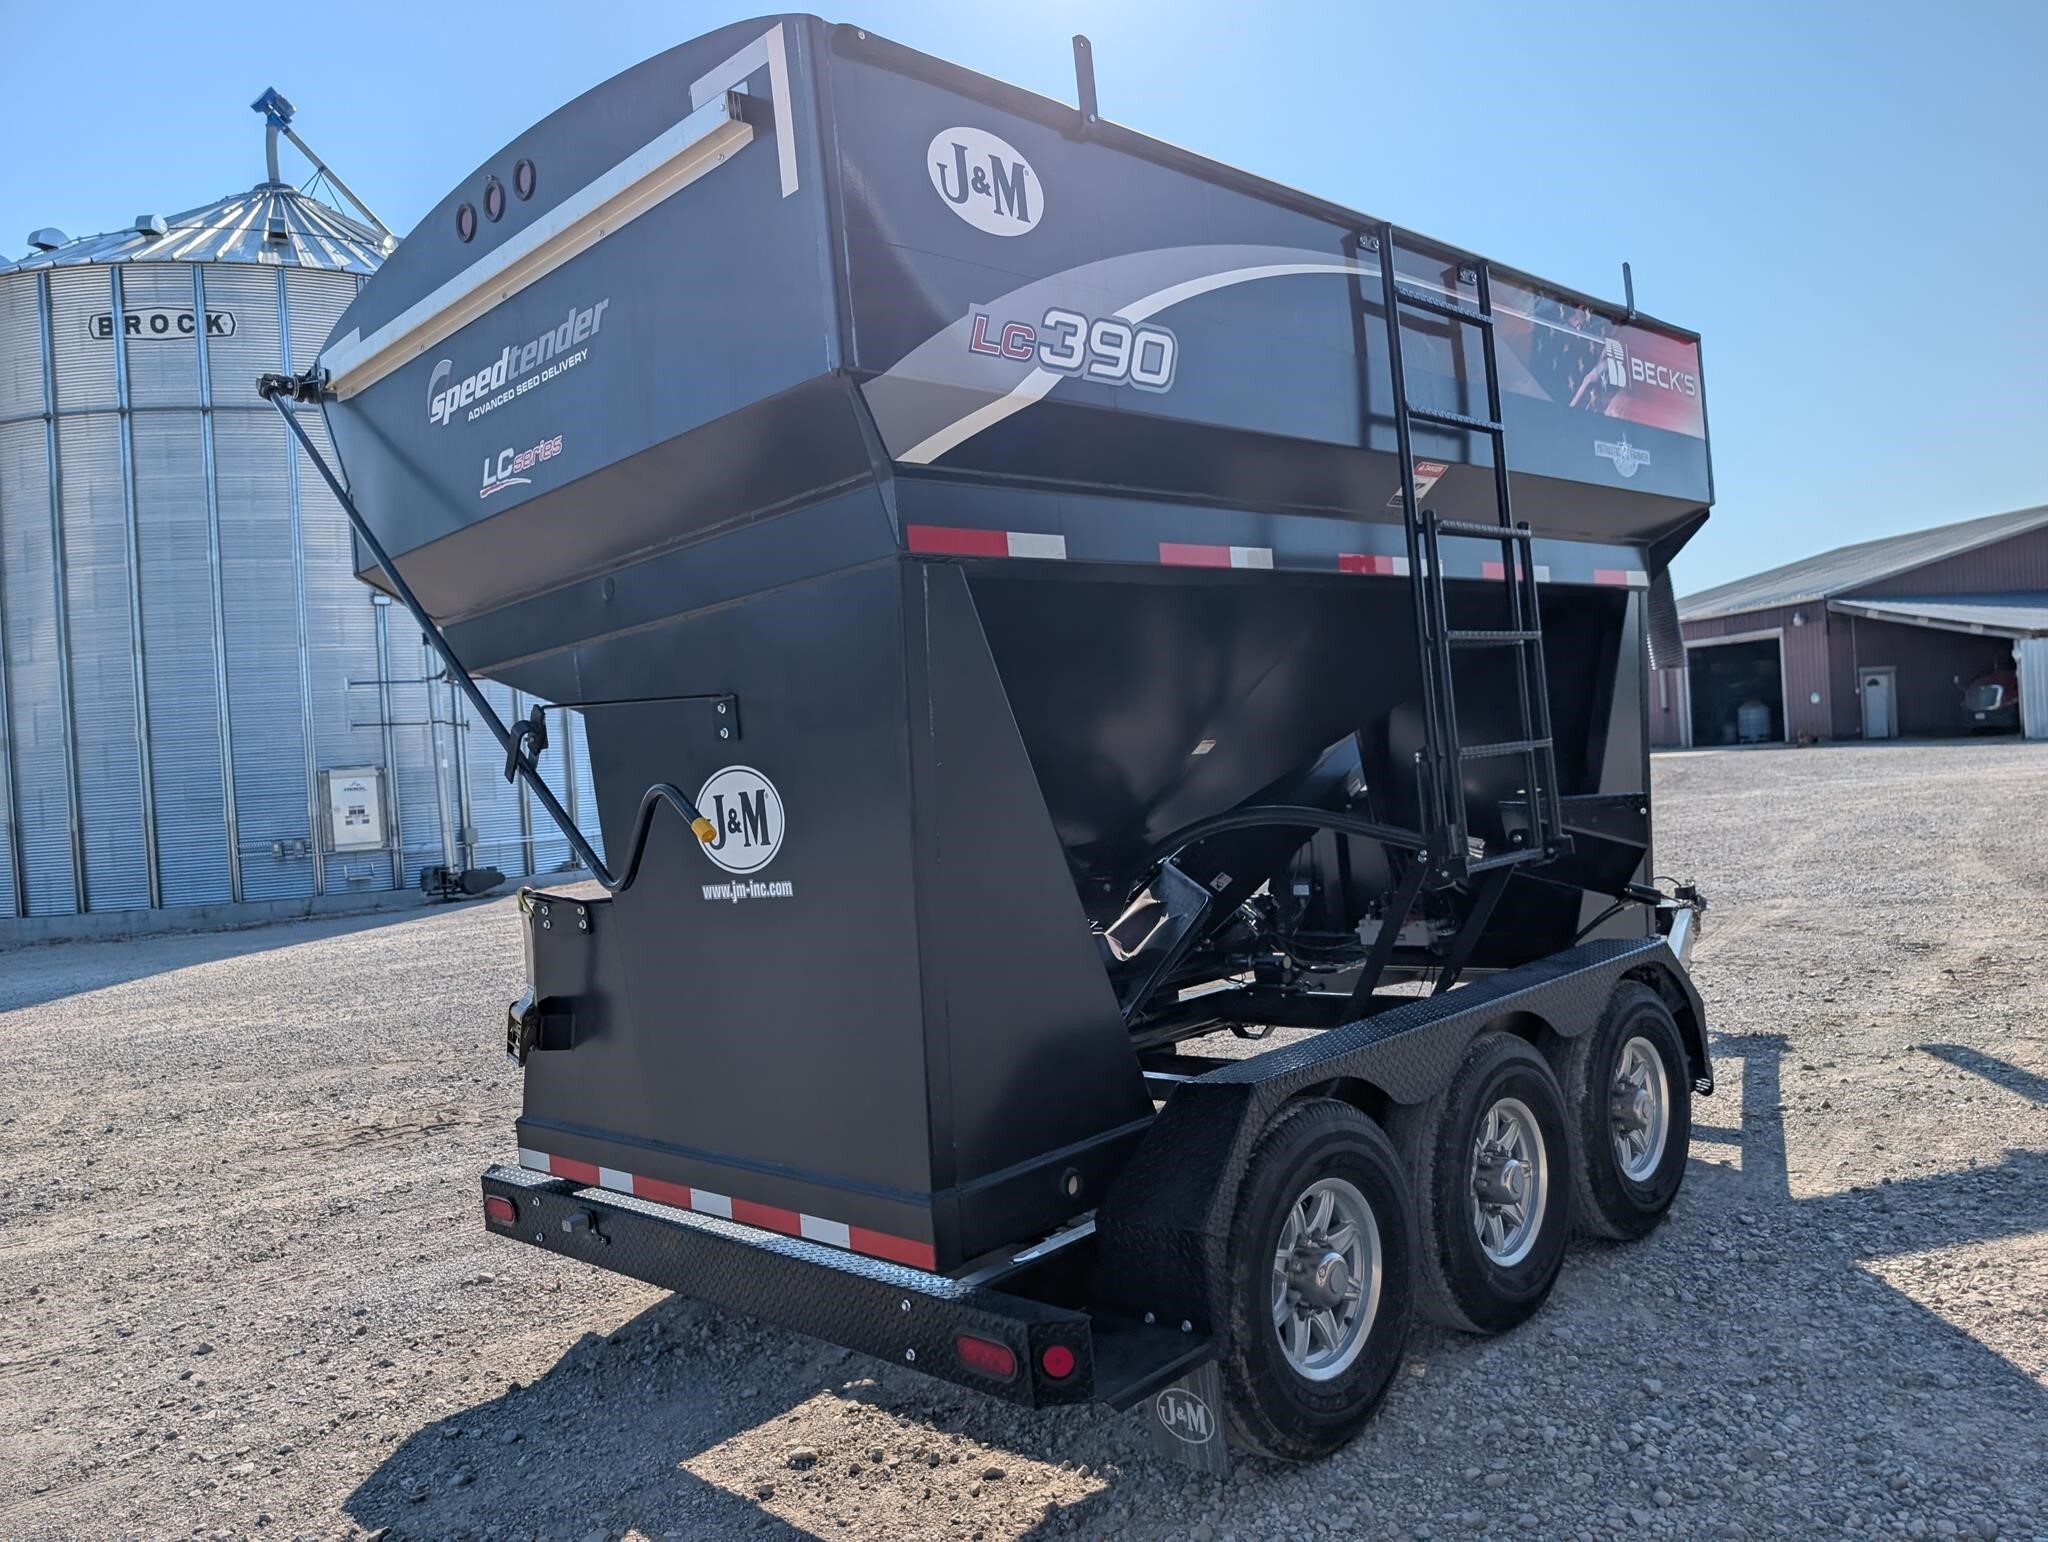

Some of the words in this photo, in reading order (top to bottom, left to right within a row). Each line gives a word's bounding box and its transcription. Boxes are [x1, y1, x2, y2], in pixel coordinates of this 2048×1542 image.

[936, 142, 1031, 223] J&M
[98, 314, 224, 336] BROCK
[467, 388, 515, 422] ADVANCED
[516, 375, 540, 396] SEED
[541, 348, 589, 383] DELIVERY
[1631, 356, 1696, 396] BECK'S
[707, 788, 771, 851] J&M
[702, 880, 794, 904] www.jm-inc.com
[1159, 1396, 1208, 1436] J&M
